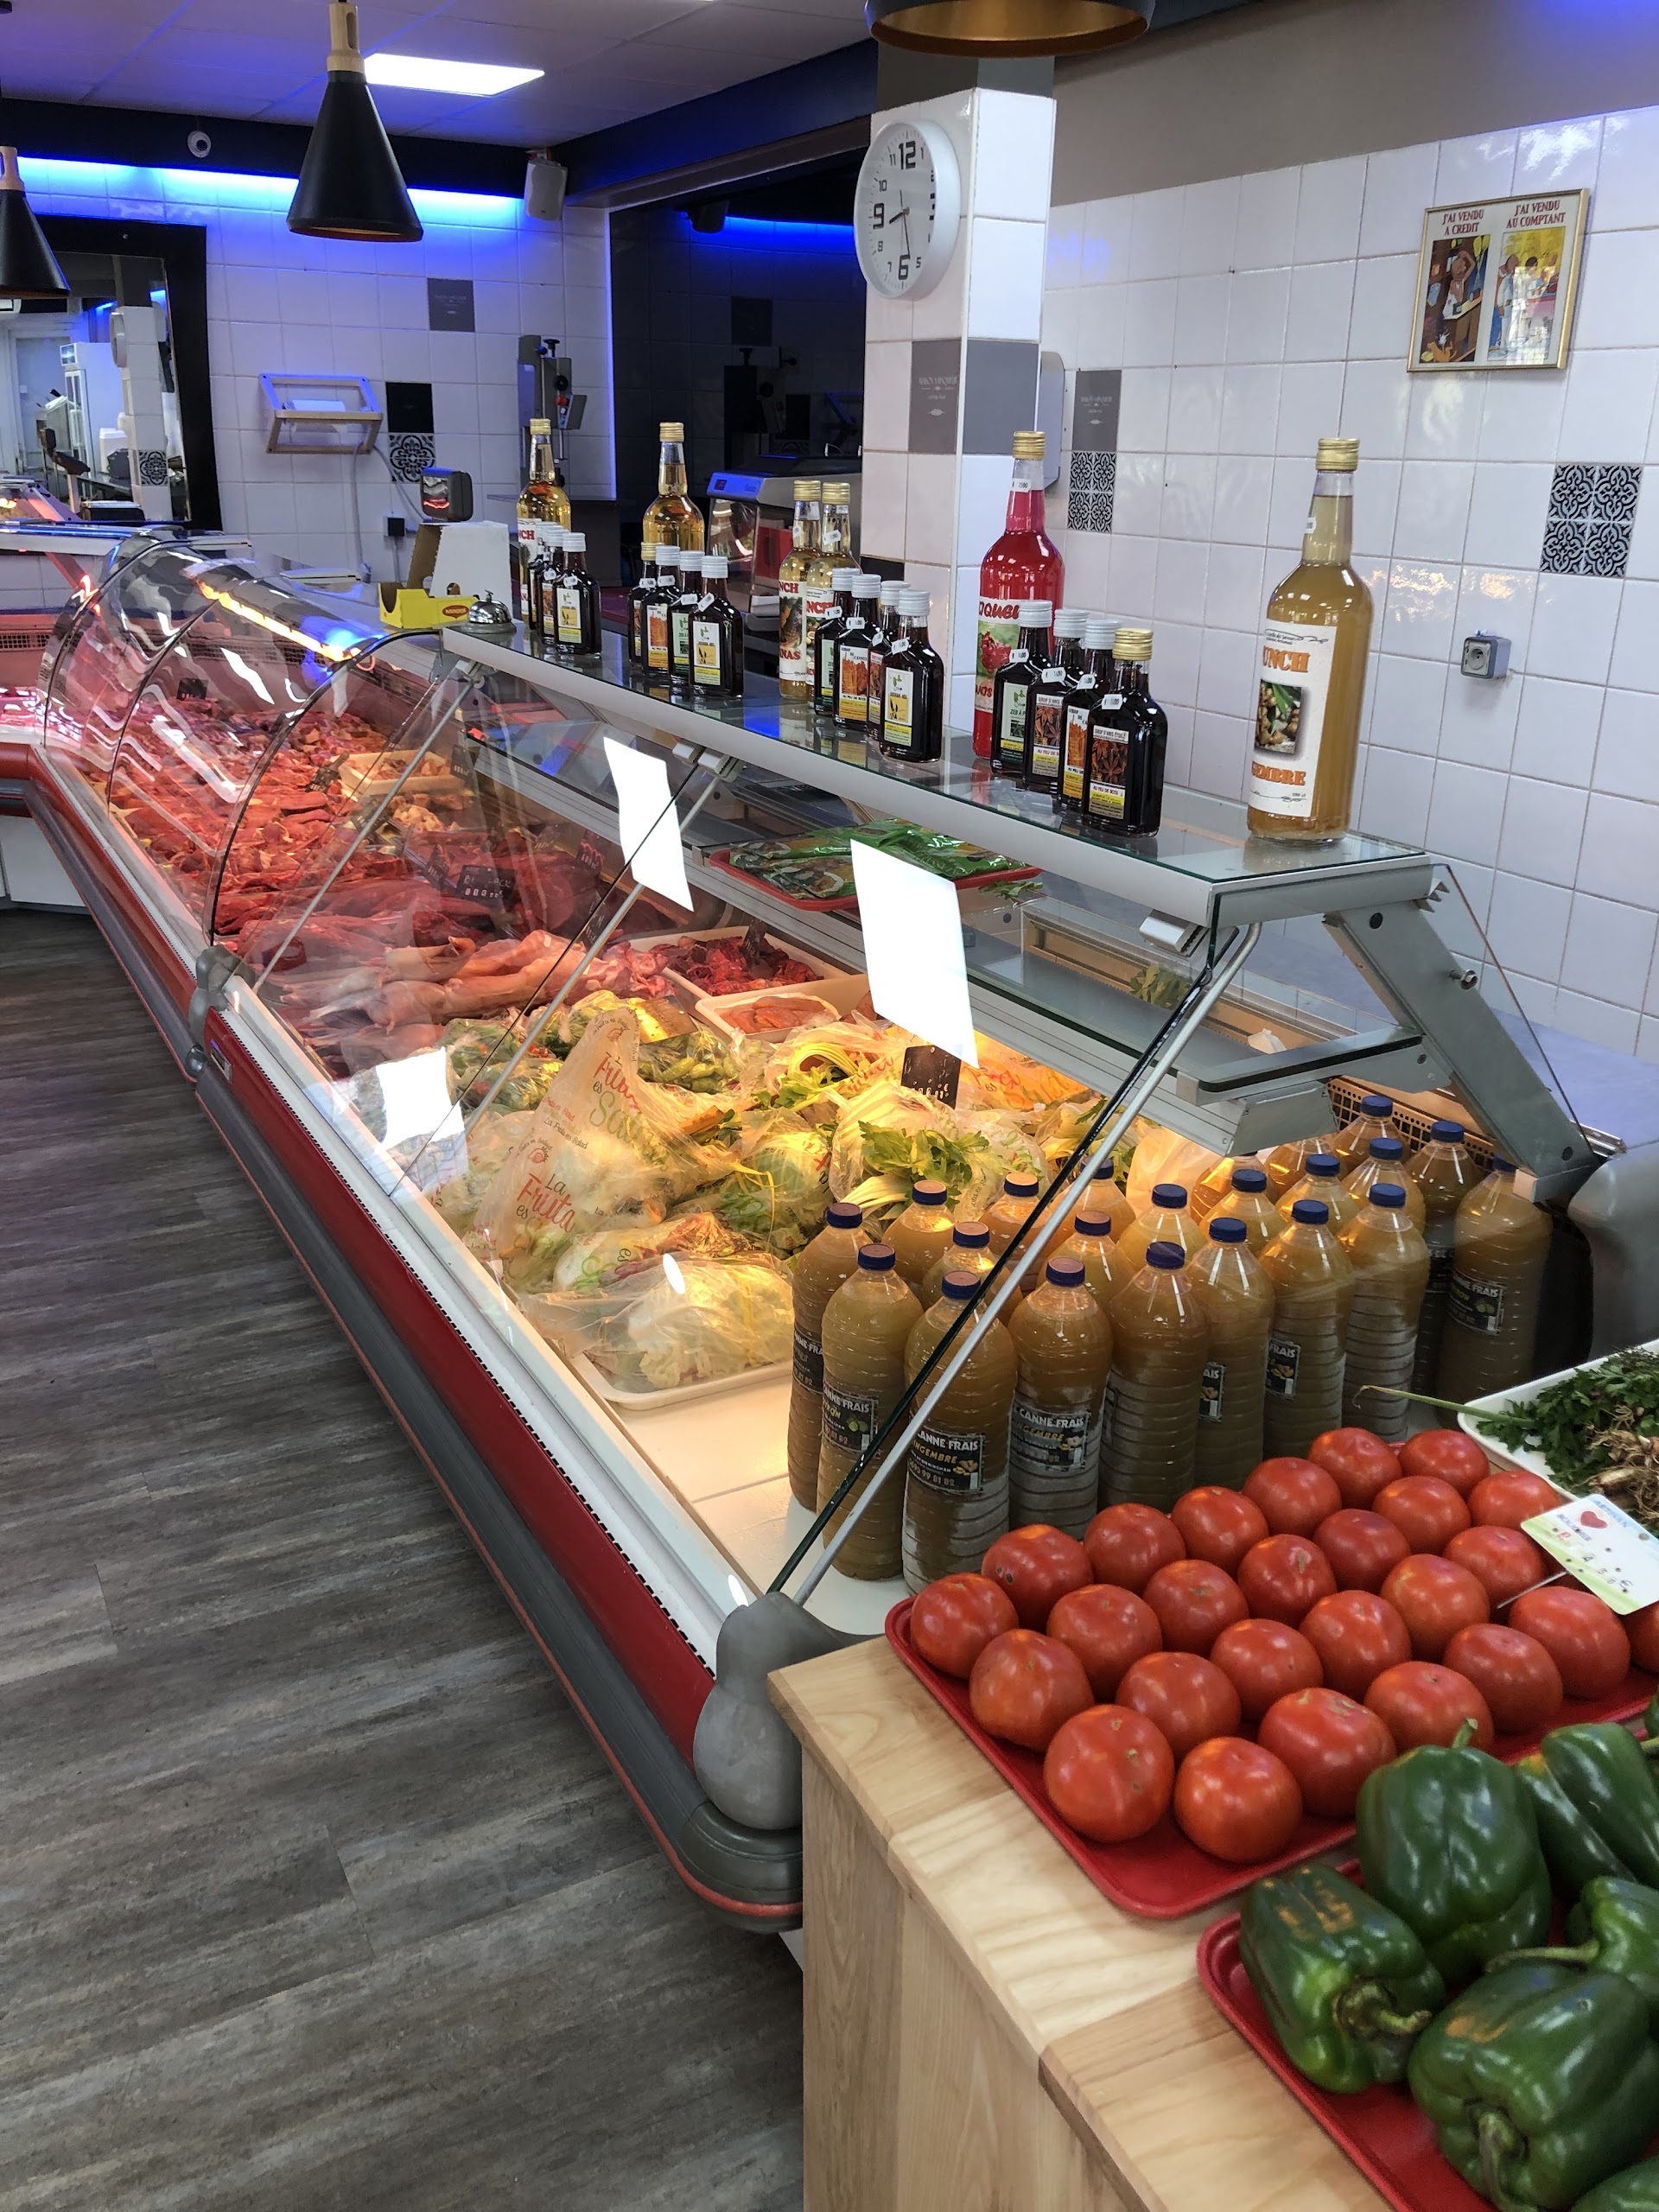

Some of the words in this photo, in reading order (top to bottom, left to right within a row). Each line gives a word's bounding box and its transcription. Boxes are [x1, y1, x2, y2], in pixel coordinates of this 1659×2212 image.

[889, 153, 897, 166] 11
[899, 141, 916, 170] 12
[879, 180, 887, 192] 10
[873, 202, 885, 229] 9
[1515, 204, 1529, 217] J'AI
[1531, 200, 1560, 213] VENDU
[1442, 213, 1456, 226] J'AI
[1459, 209, 1484, 222] VENDU
[1506, 218, 1518, 229] AU
[1520, 212, 1567, 227] COMPTANT
[1452, 222, 1480, 235] CREDIT
[877, 240, 884, 252] 8
[887, 261, 893, 273] 7
[898, 254, 909, 281] 6
[915, 257, 922, 269] 5
[544, 1173, 566, 1195] La
[517, 1173, 576, 1234] Fruta
[516, 1205, 528, 1220] es
[1269, 1343, 1296, 1358] FRAIS
[842, 1398, 870, 1414] FRAIS
[1020, 1408, 1054, 1427] CANNE
[1056, 1418, 1084, 1429] FRAIS
[948, 1440, 978, 1452] FRAIS
